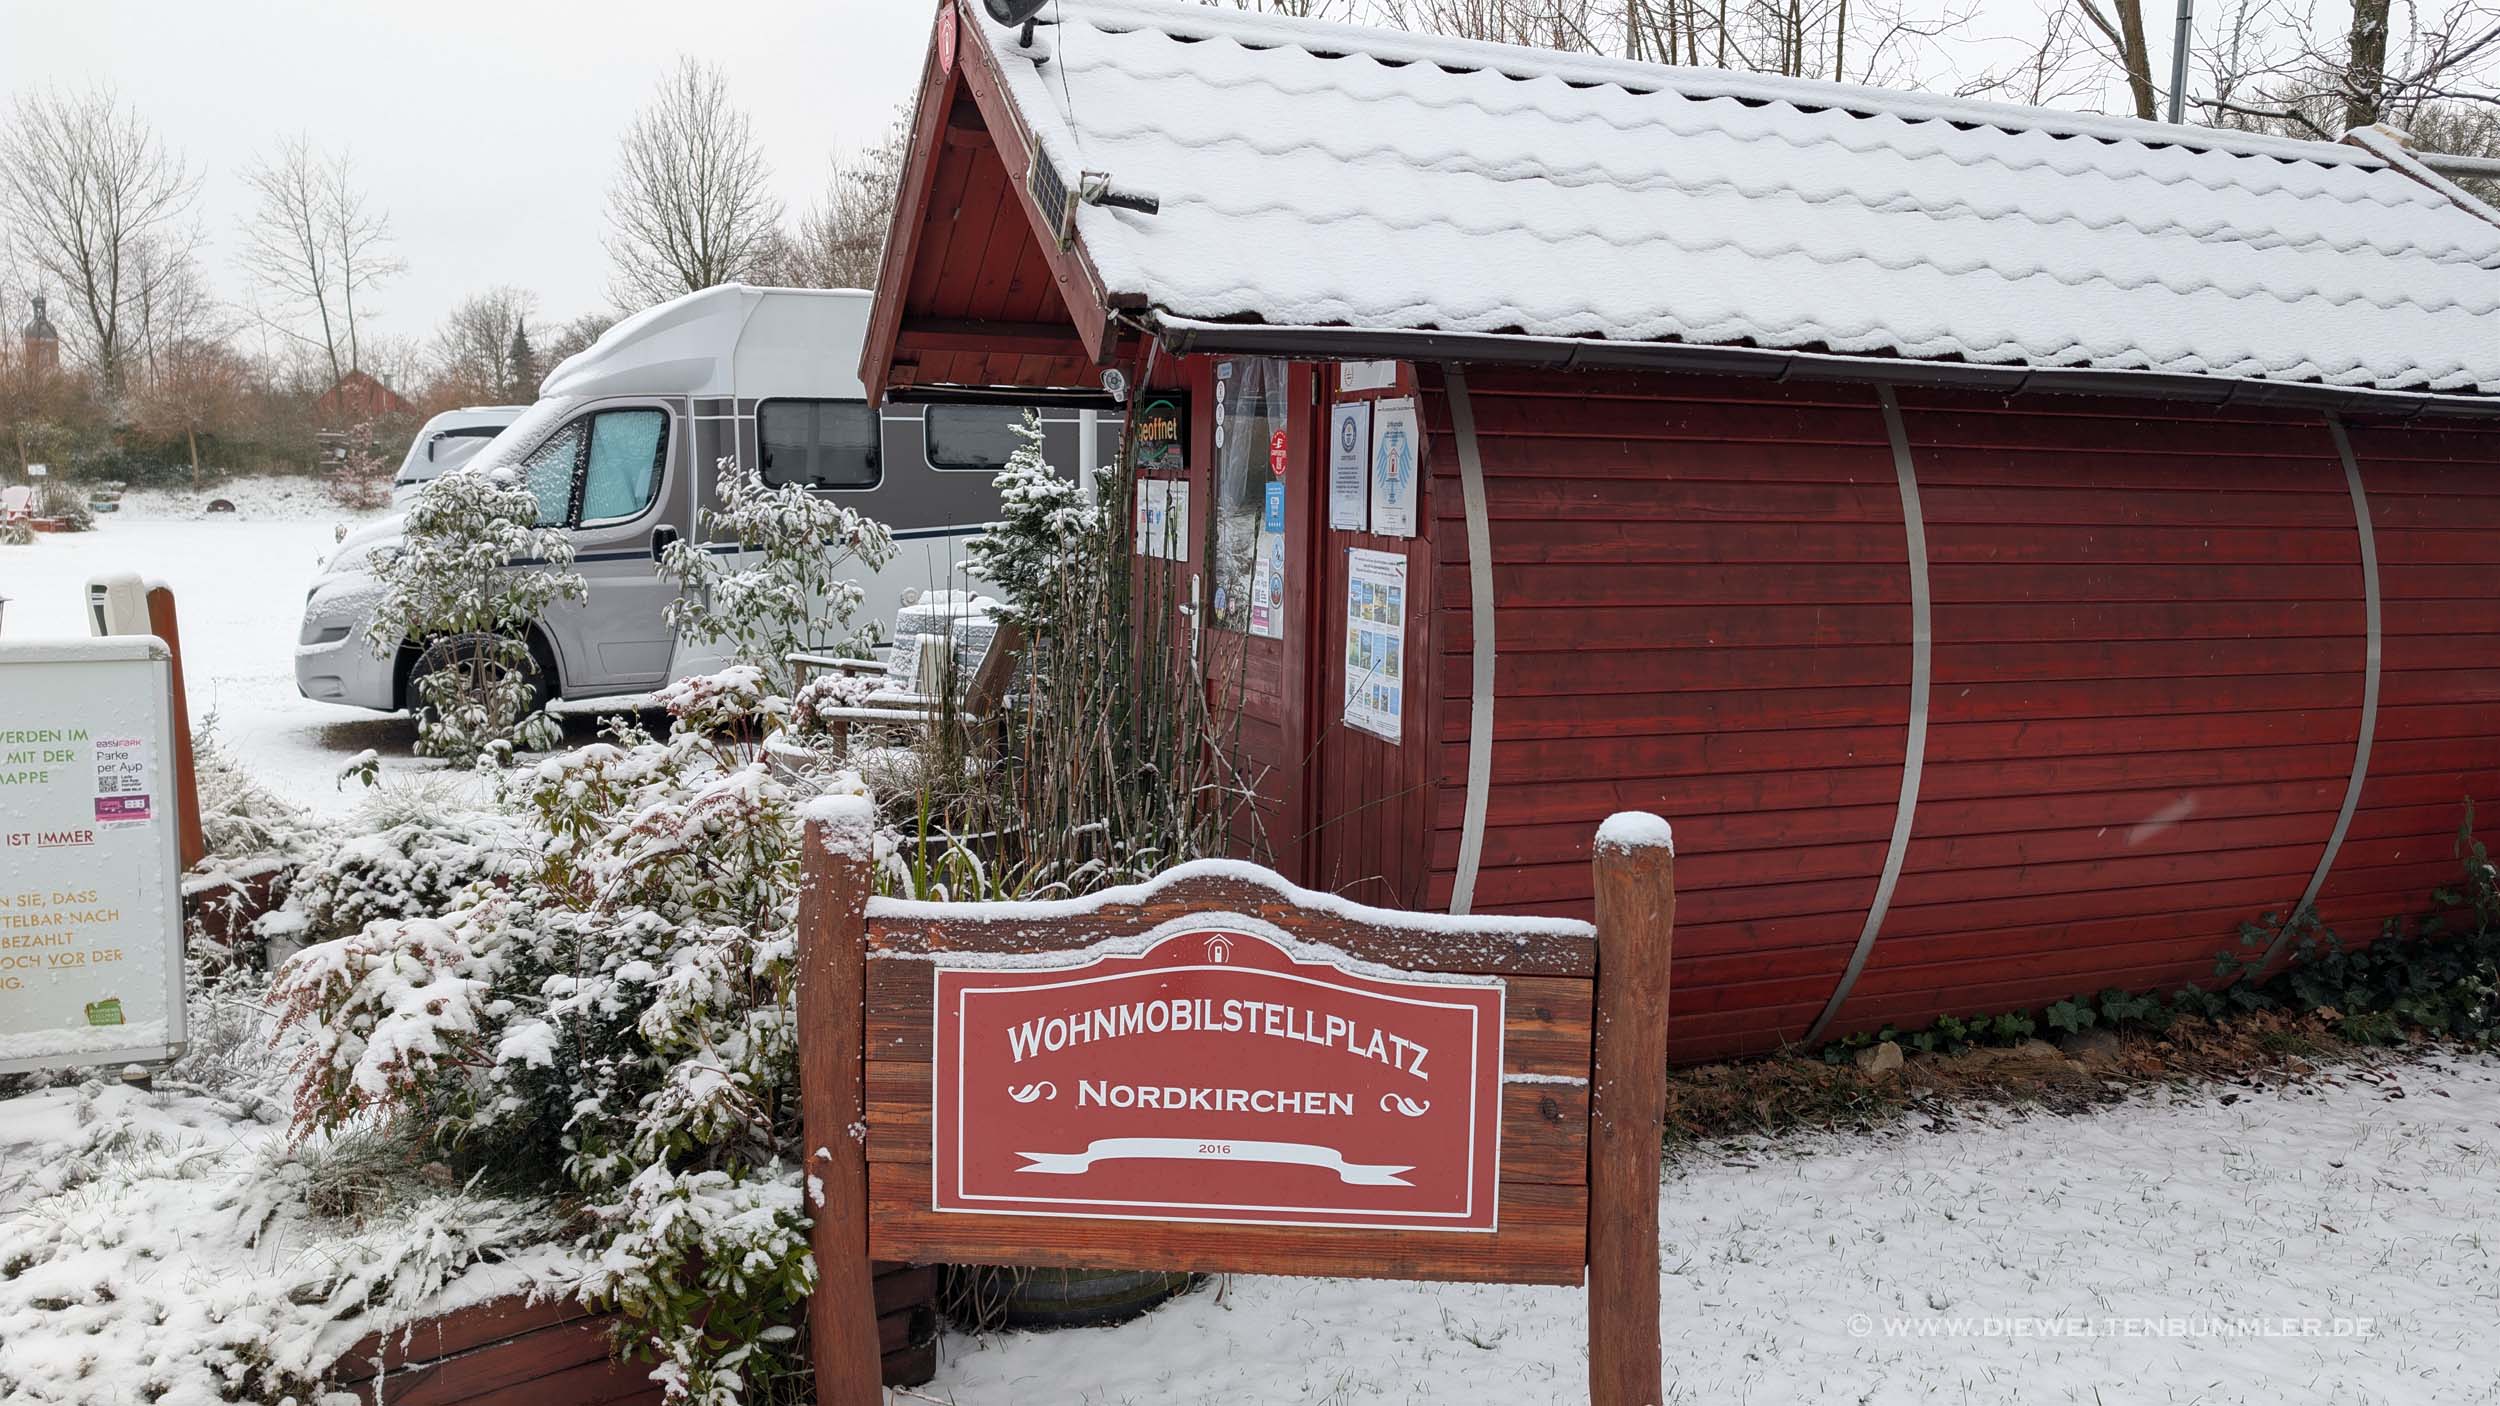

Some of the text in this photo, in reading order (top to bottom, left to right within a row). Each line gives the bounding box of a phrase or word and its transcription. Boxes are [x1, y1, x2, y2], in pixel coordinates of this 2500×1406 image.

[0, 729, 88, 744] ERDEN IM
[6, 751, 76, 764] MIT DER
[97, 751, 128, 761] Parke
[97, 762, 143, 775] per App
[6, 830, 94, 846] IST IMMER
[17, 893, 46, 908] SIE,
[52, 890, 98, 905] DASS
[0, 909, 119, 928] TELBAR NACH
[1, 932, 73, 949] BEZAHLT
[48, 952, 86, 966] VOR
[92, 949, 123, 963] DER
[1007, 998, 1429, 1081] WOHNMOBILSTELLPLATZ
[1077, 1080, 1354, 1116] NORDKIRCHEN
[1198, 1144, 1231, 1154] 2016
